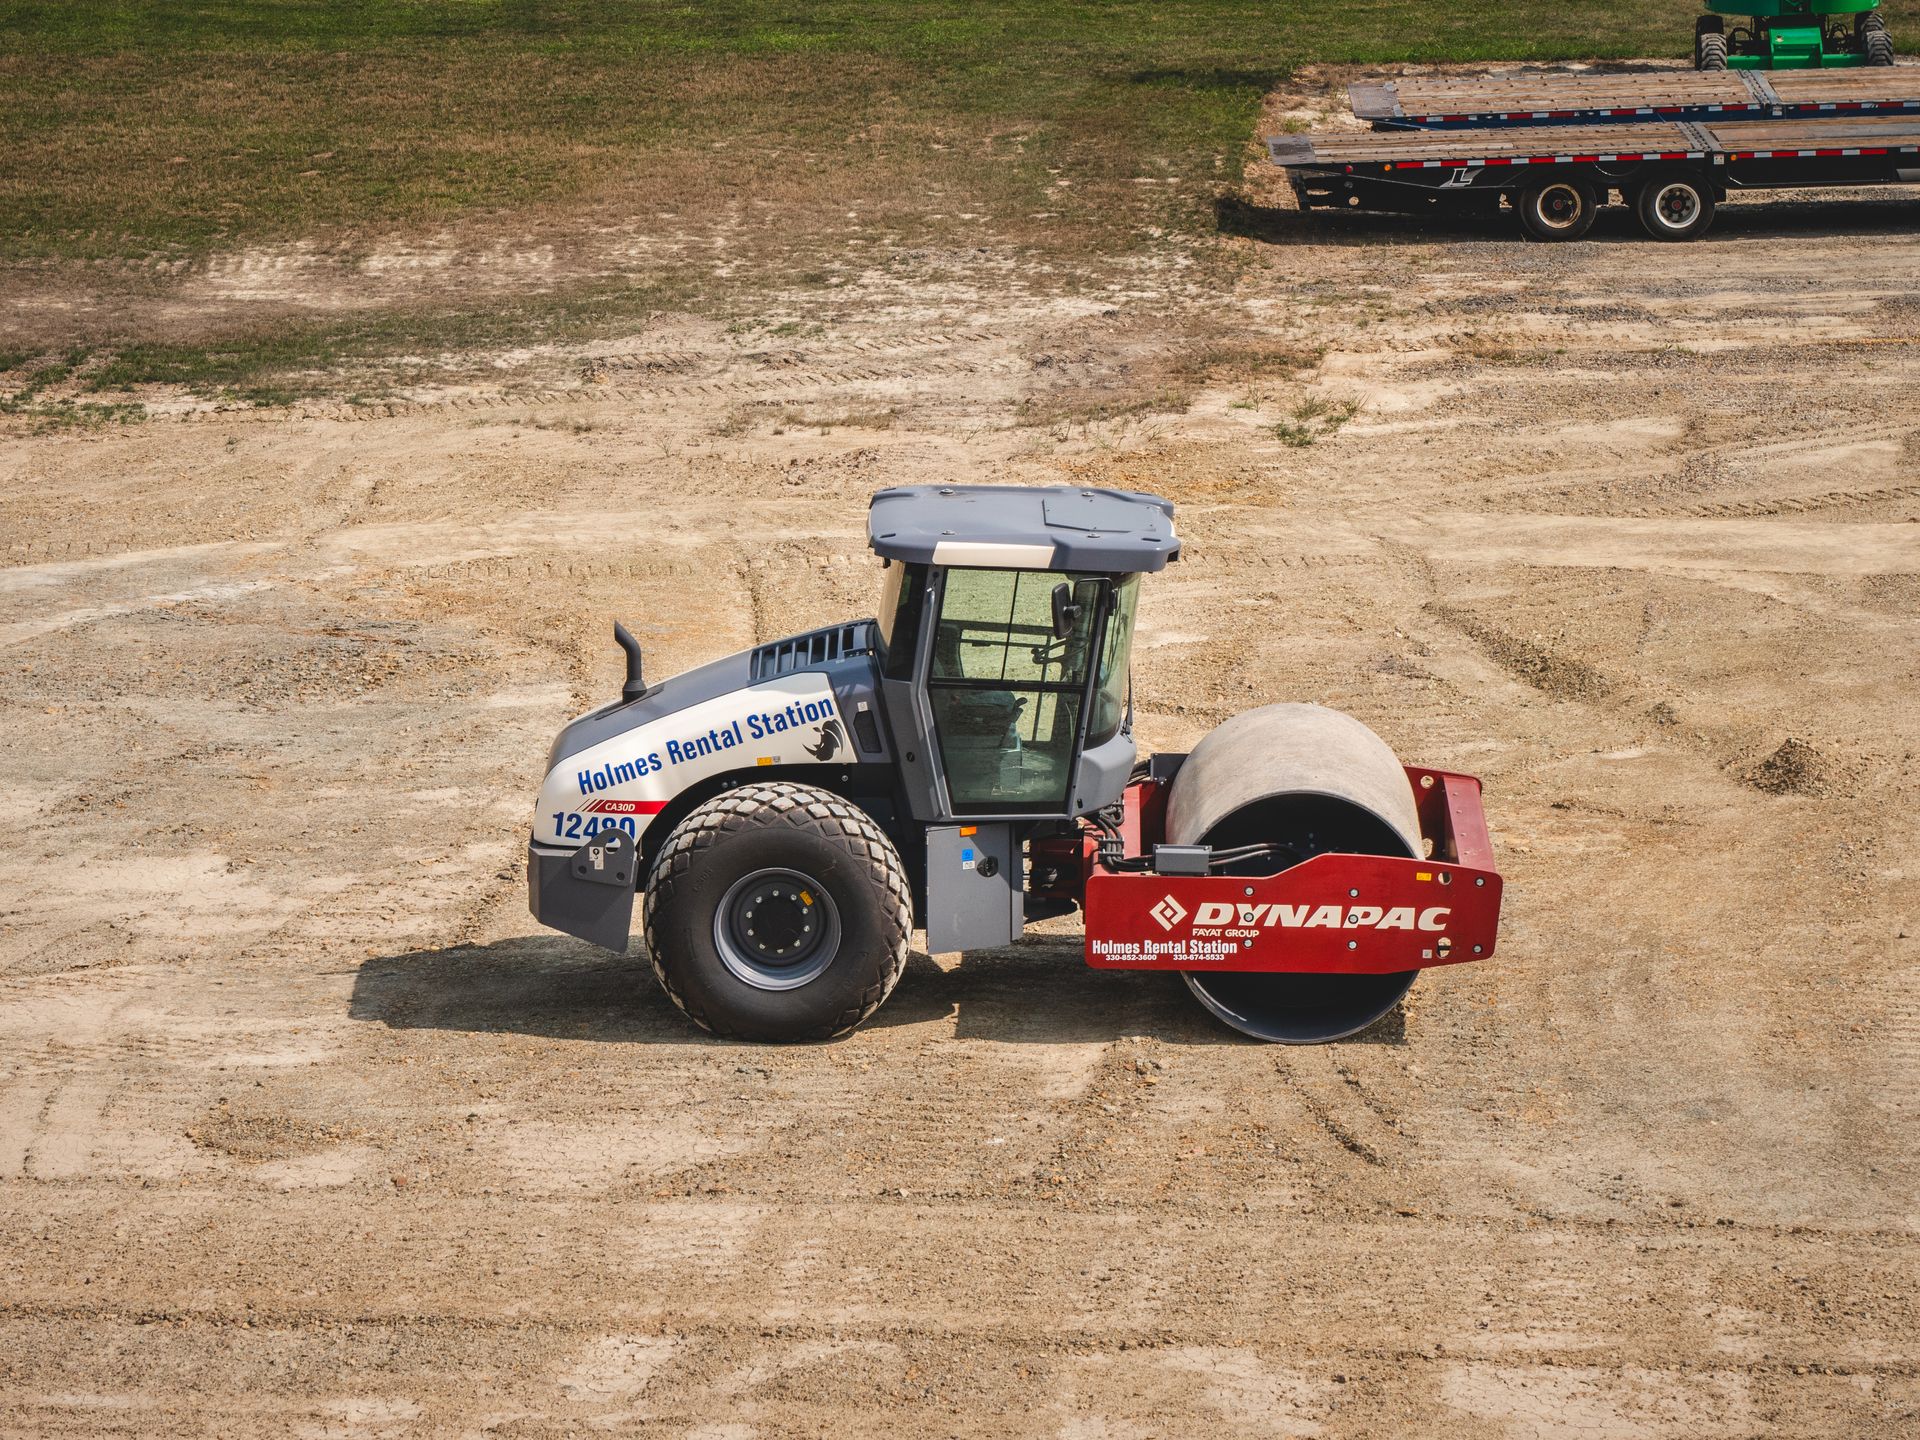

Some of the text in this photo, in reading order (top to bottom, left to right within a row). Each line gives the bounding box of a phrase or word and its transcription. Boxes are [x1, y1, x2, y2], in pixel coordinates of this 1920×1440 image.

[578, 698, 834, 795] Holmes Rental Station
[605, 803, 636, 812] CA30D
[1192, 902, 1452, 931] DYNAPAC
[1192, 928, 1260, 938] FAYAT GROUP
[1092, 940, 1238, 954] Holmes Rental Station
